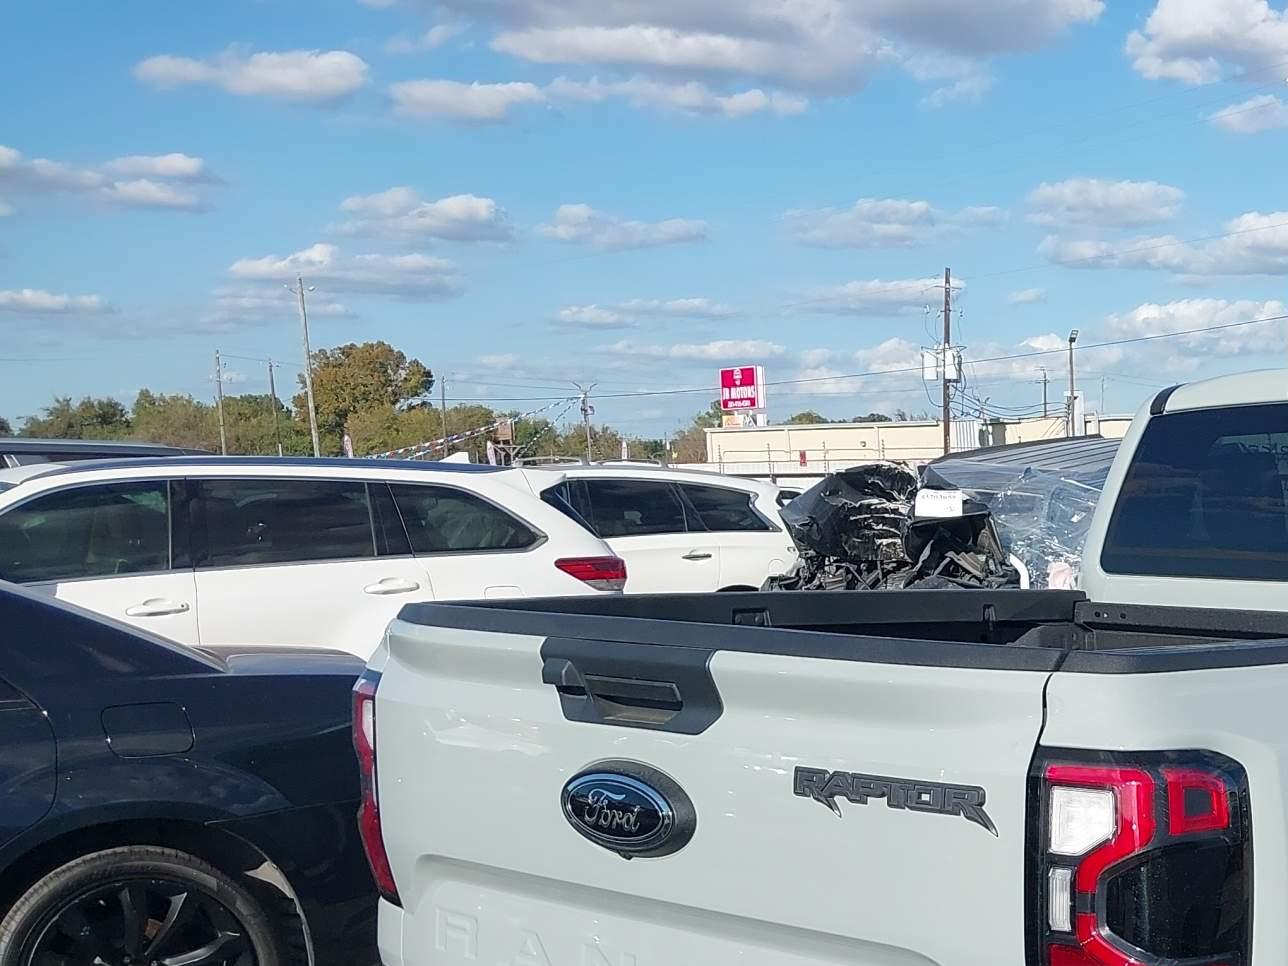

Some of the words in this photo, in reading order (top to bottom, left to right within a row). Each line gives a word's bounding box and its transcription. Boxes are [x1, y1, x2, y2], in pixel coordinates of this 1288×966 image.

[731, 385, 755, 399] MOTORS
[585, 788, 642, 833] Ford
[793, 765, 999, 837] RAPTOR
